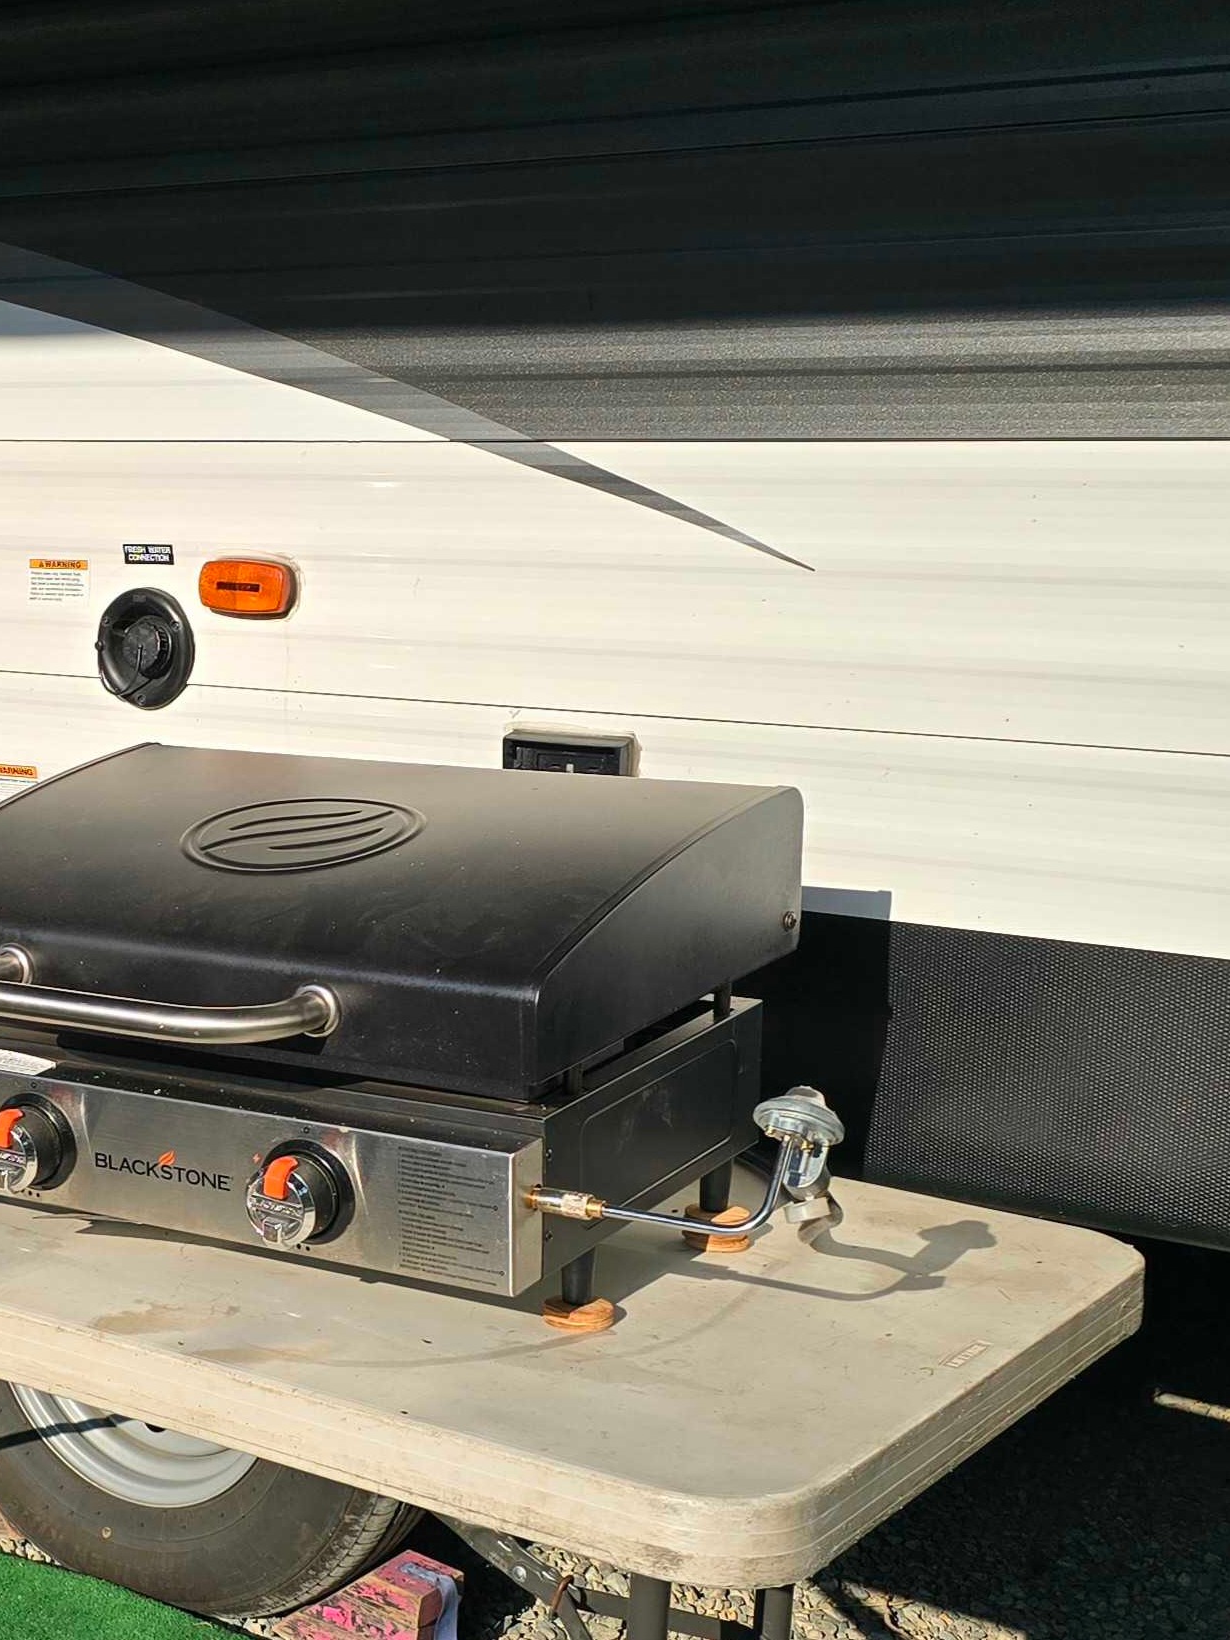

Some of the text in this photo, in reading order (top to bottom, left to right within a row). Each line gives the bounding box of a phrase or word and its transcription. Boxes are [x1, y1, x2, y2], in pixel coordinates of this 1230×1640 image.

[124, 545, 171, 555] FRESH WATER
[128, 553, 170, 562] CONNECTION
[44, 560, 82, 569] WARNING
[95, 1152, 232, 1192] BLACKSTONE
